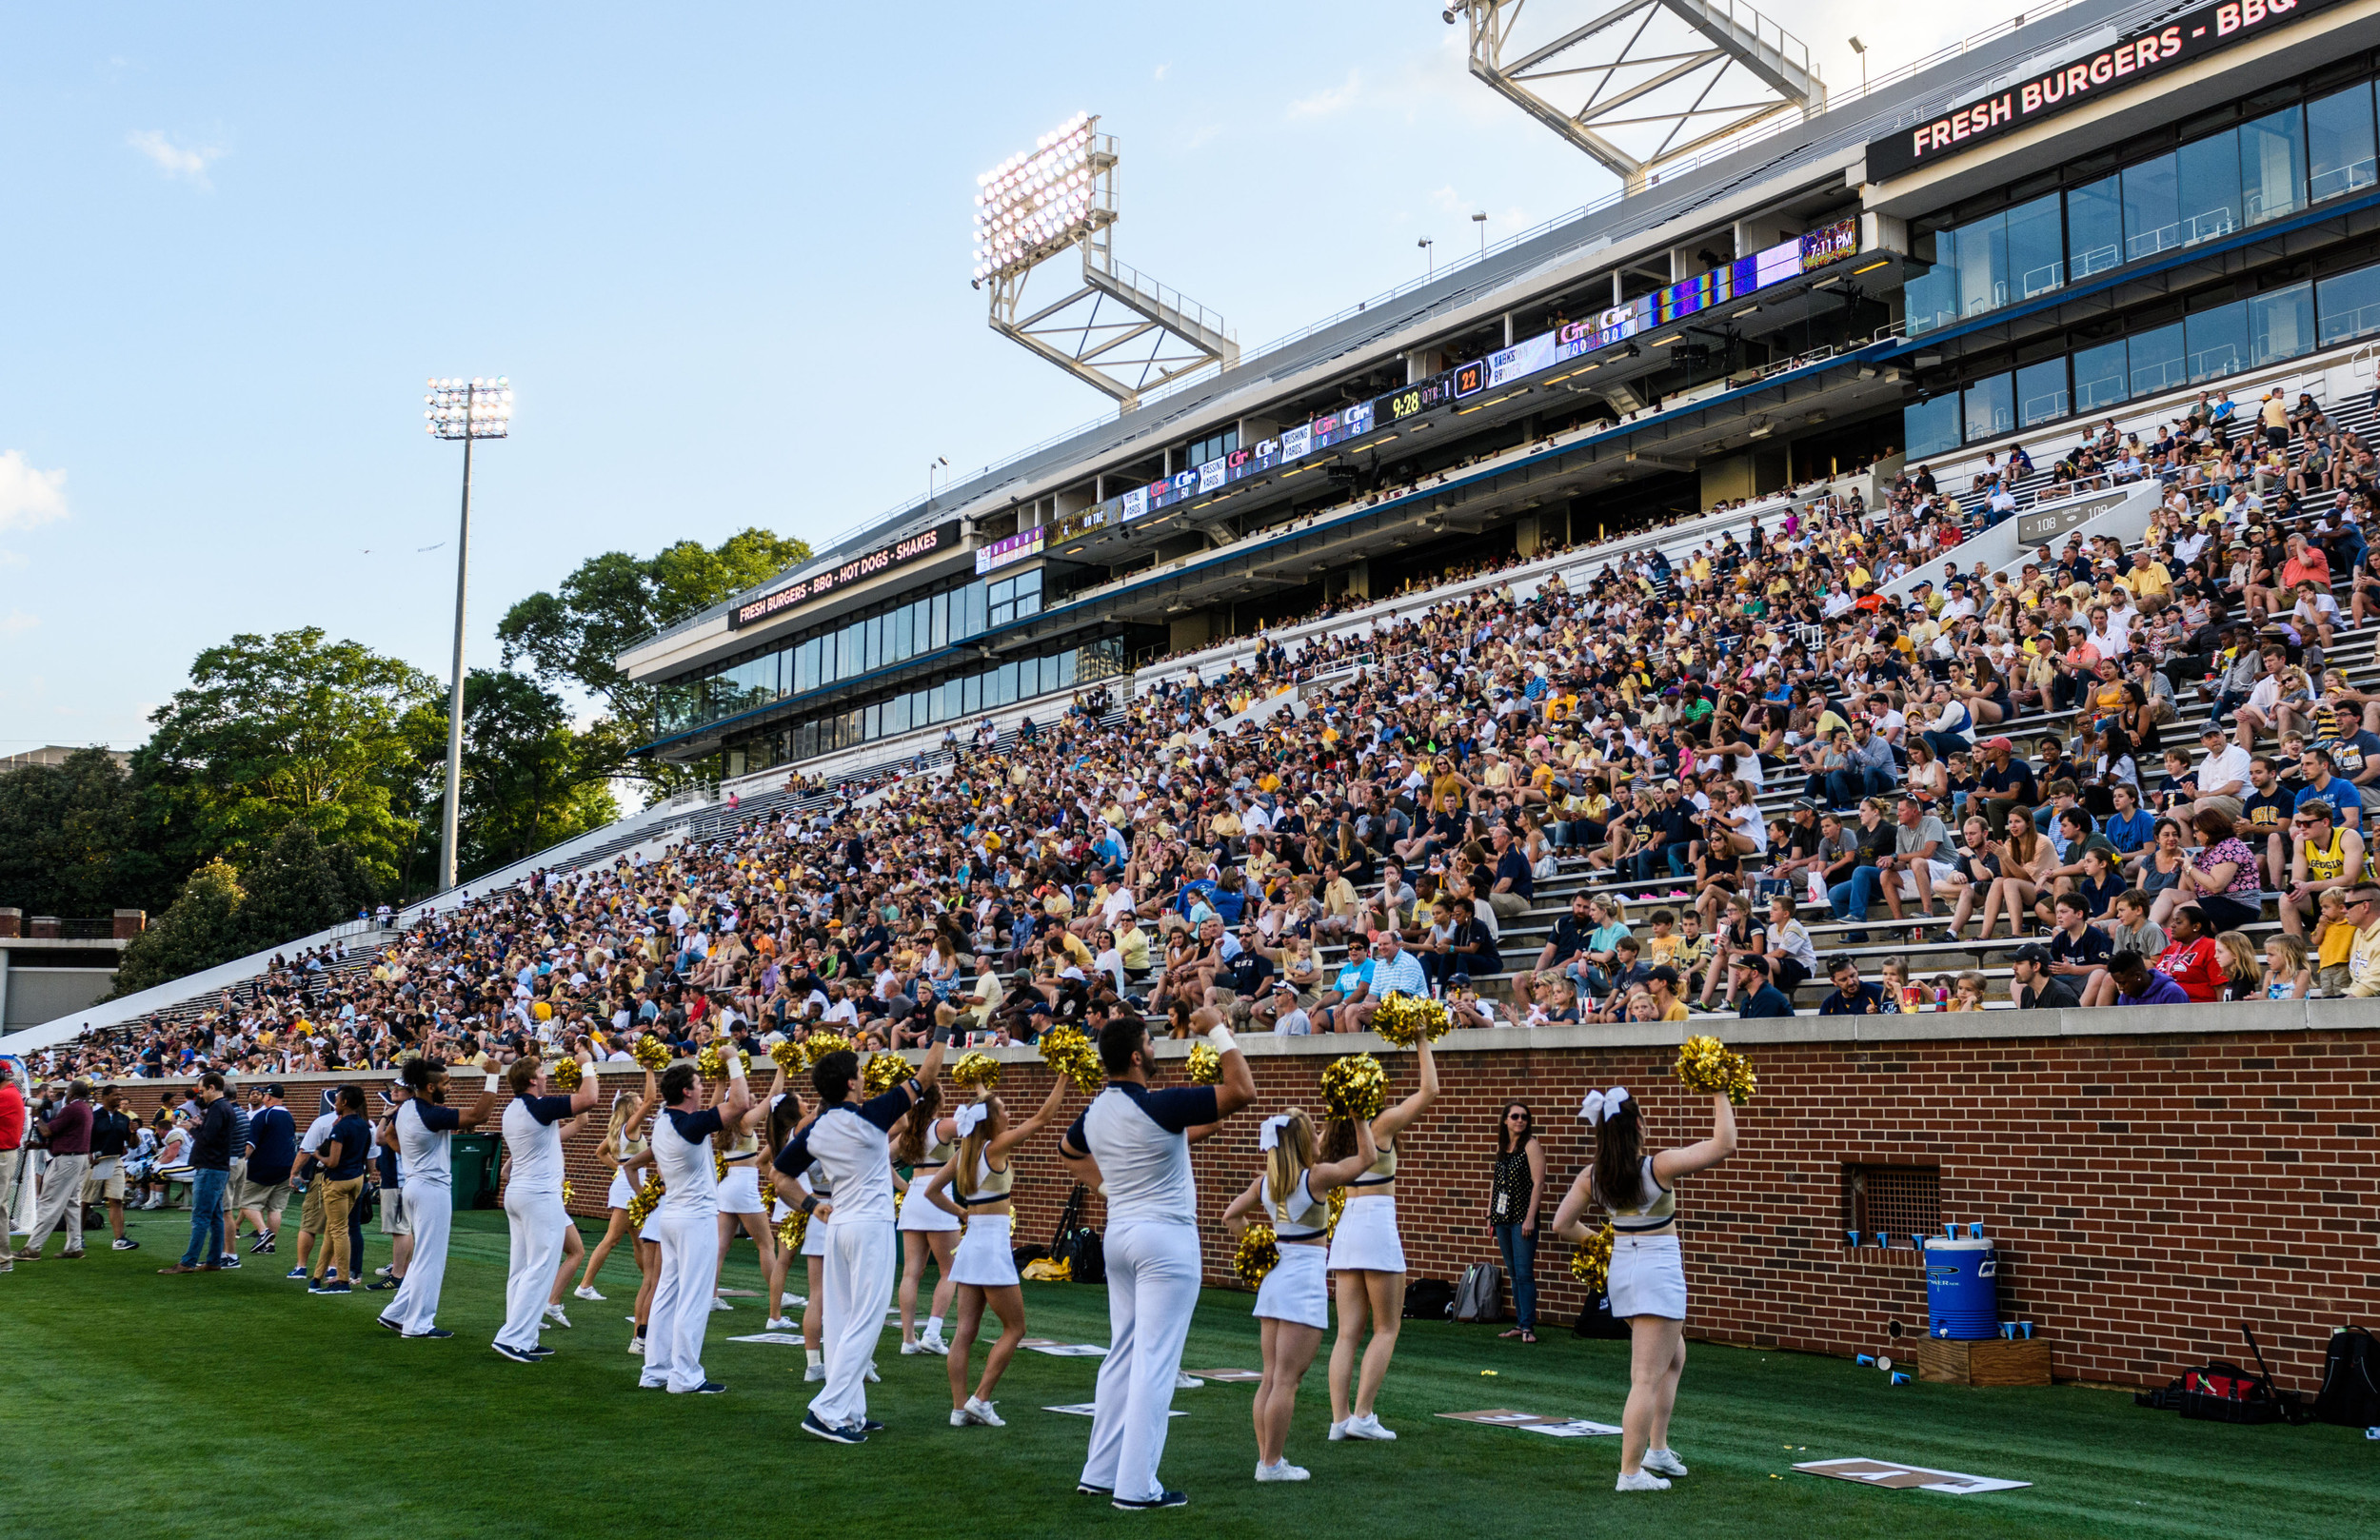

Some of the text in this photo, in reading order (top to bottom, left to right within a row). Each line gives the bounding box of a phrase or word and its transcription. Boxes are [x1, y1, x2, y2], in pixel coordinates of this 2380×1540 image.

[1913, 94, 2012, 157] FRESH
[2021, 26, 2182, 114] BURGERS
[1811, 231, 1853, 259] 7:11 PM
[1461, 369, 1477, 391] 22
[1444, 380, 1450, 397] 1
[1393, 391, 1419, 419] 9:28
[1285, 427, 1308, 445] RUSHING
[1352, 423, 1360, 434] 45
[1285, 444, 1302, 458] YARDS
[1202, 459, 1223, 475] PASSING
[1202, 474, 1219, 489] YARDS
[1126, 491, 1140, 504] TOTAL
[1126, 503, 1141, 516] YARDS
[2036, 517, 2056, 532] 108
[740, 600, 765, 622] FRESH
[766, 585, 807, 612] BURGERS
[813, 573, 833, 594] BBQ
[840, 564, 860, 584] HOT
[861, 549, 889, 575] DOGS
[896, 530, 938, 561] SHAKES
[2311, 859, 2344, 869] GEOGIA
